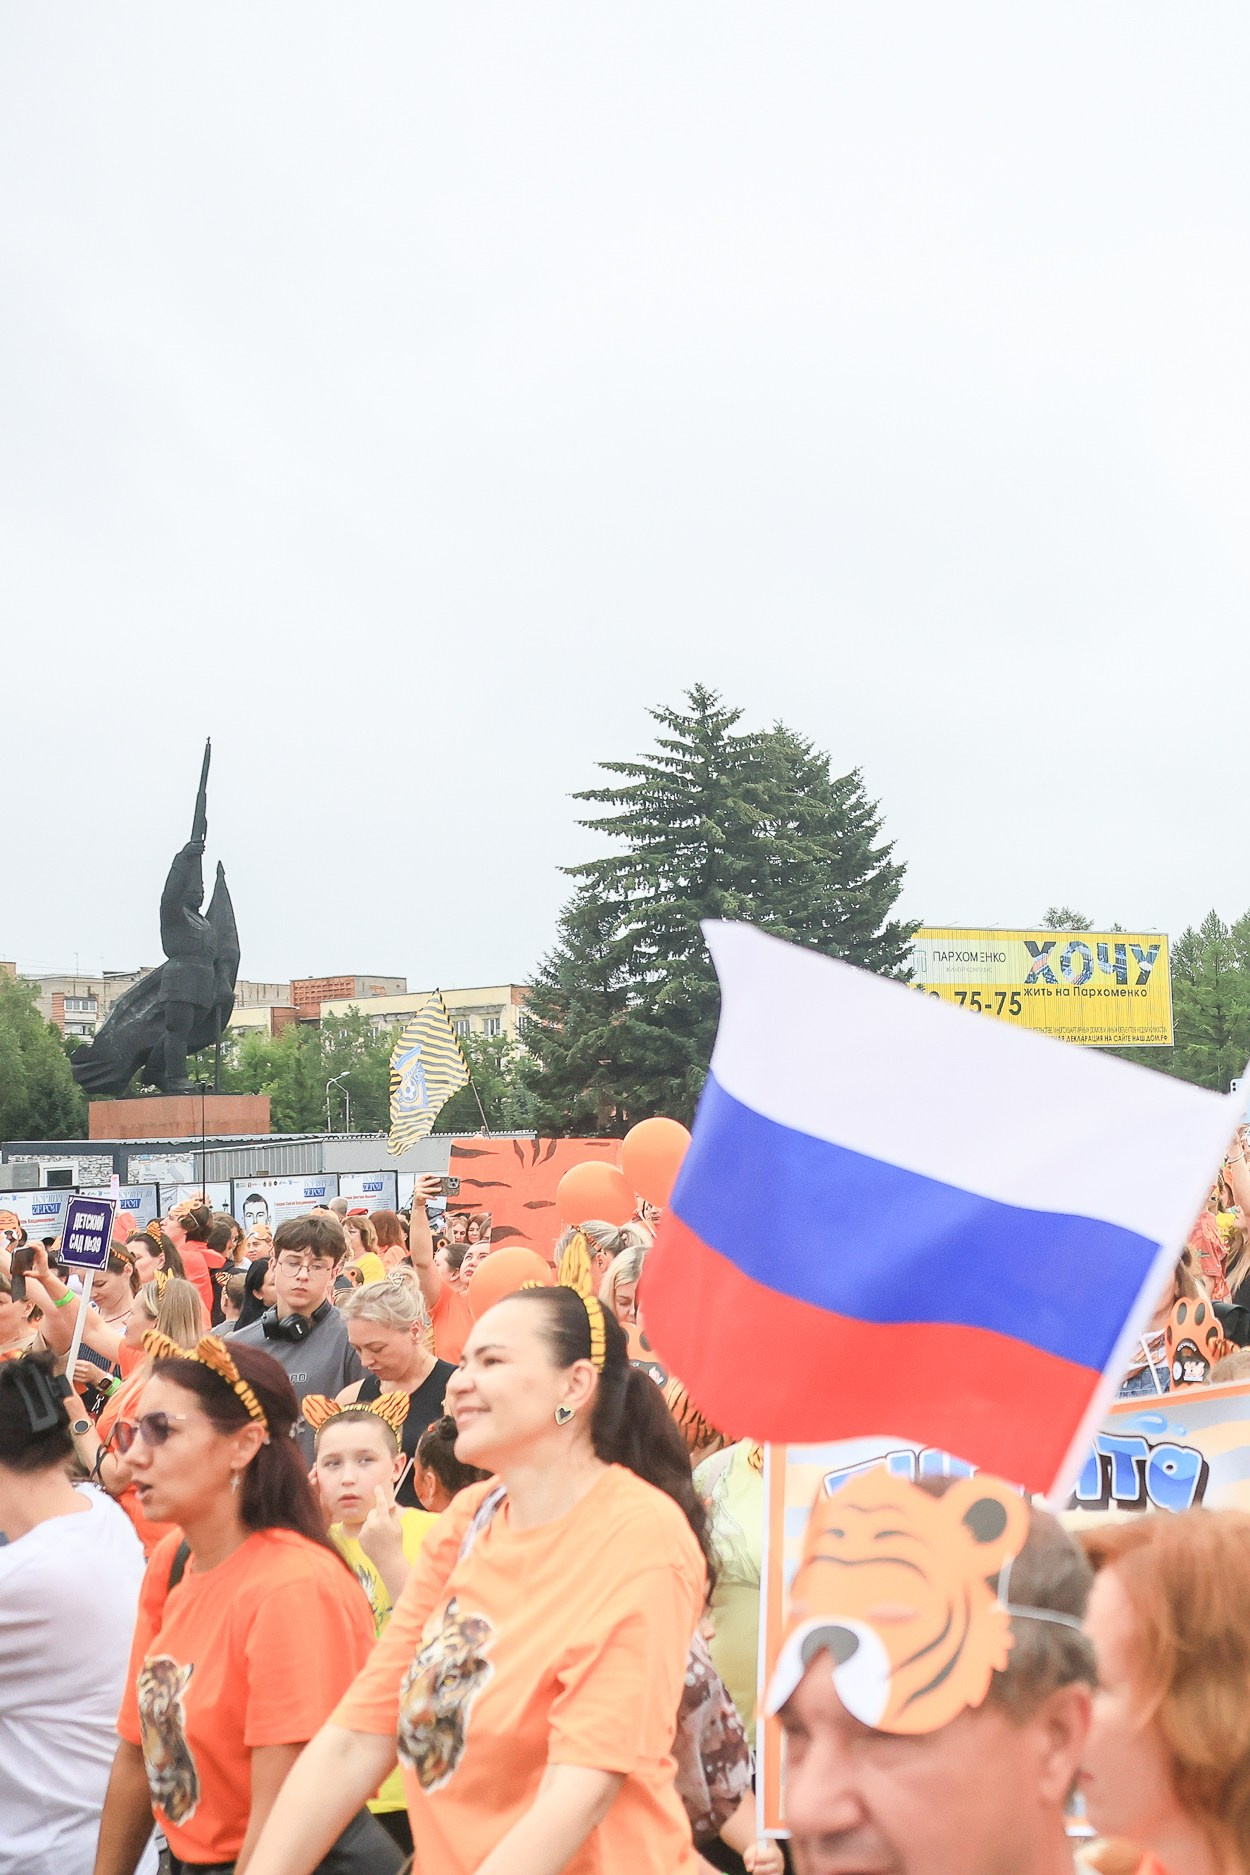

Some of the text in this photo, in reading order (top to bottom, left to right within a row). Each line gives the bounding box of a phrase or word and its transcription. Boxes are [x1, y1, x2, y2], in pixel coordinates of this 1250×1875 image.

[932, 951, 1006, 963] ПАРХОМЕНКО
[1023, 940, 1161, 985] ХОЧУ
[1023, 986, 1148, 999] жить на Пархоменко
[1113, 1034, 1131, 1042] САЙТЕ
[72, 1212, 105, 1232] ДЕТСКИЙ
[69, 1233, 102, 1253] САД №39
